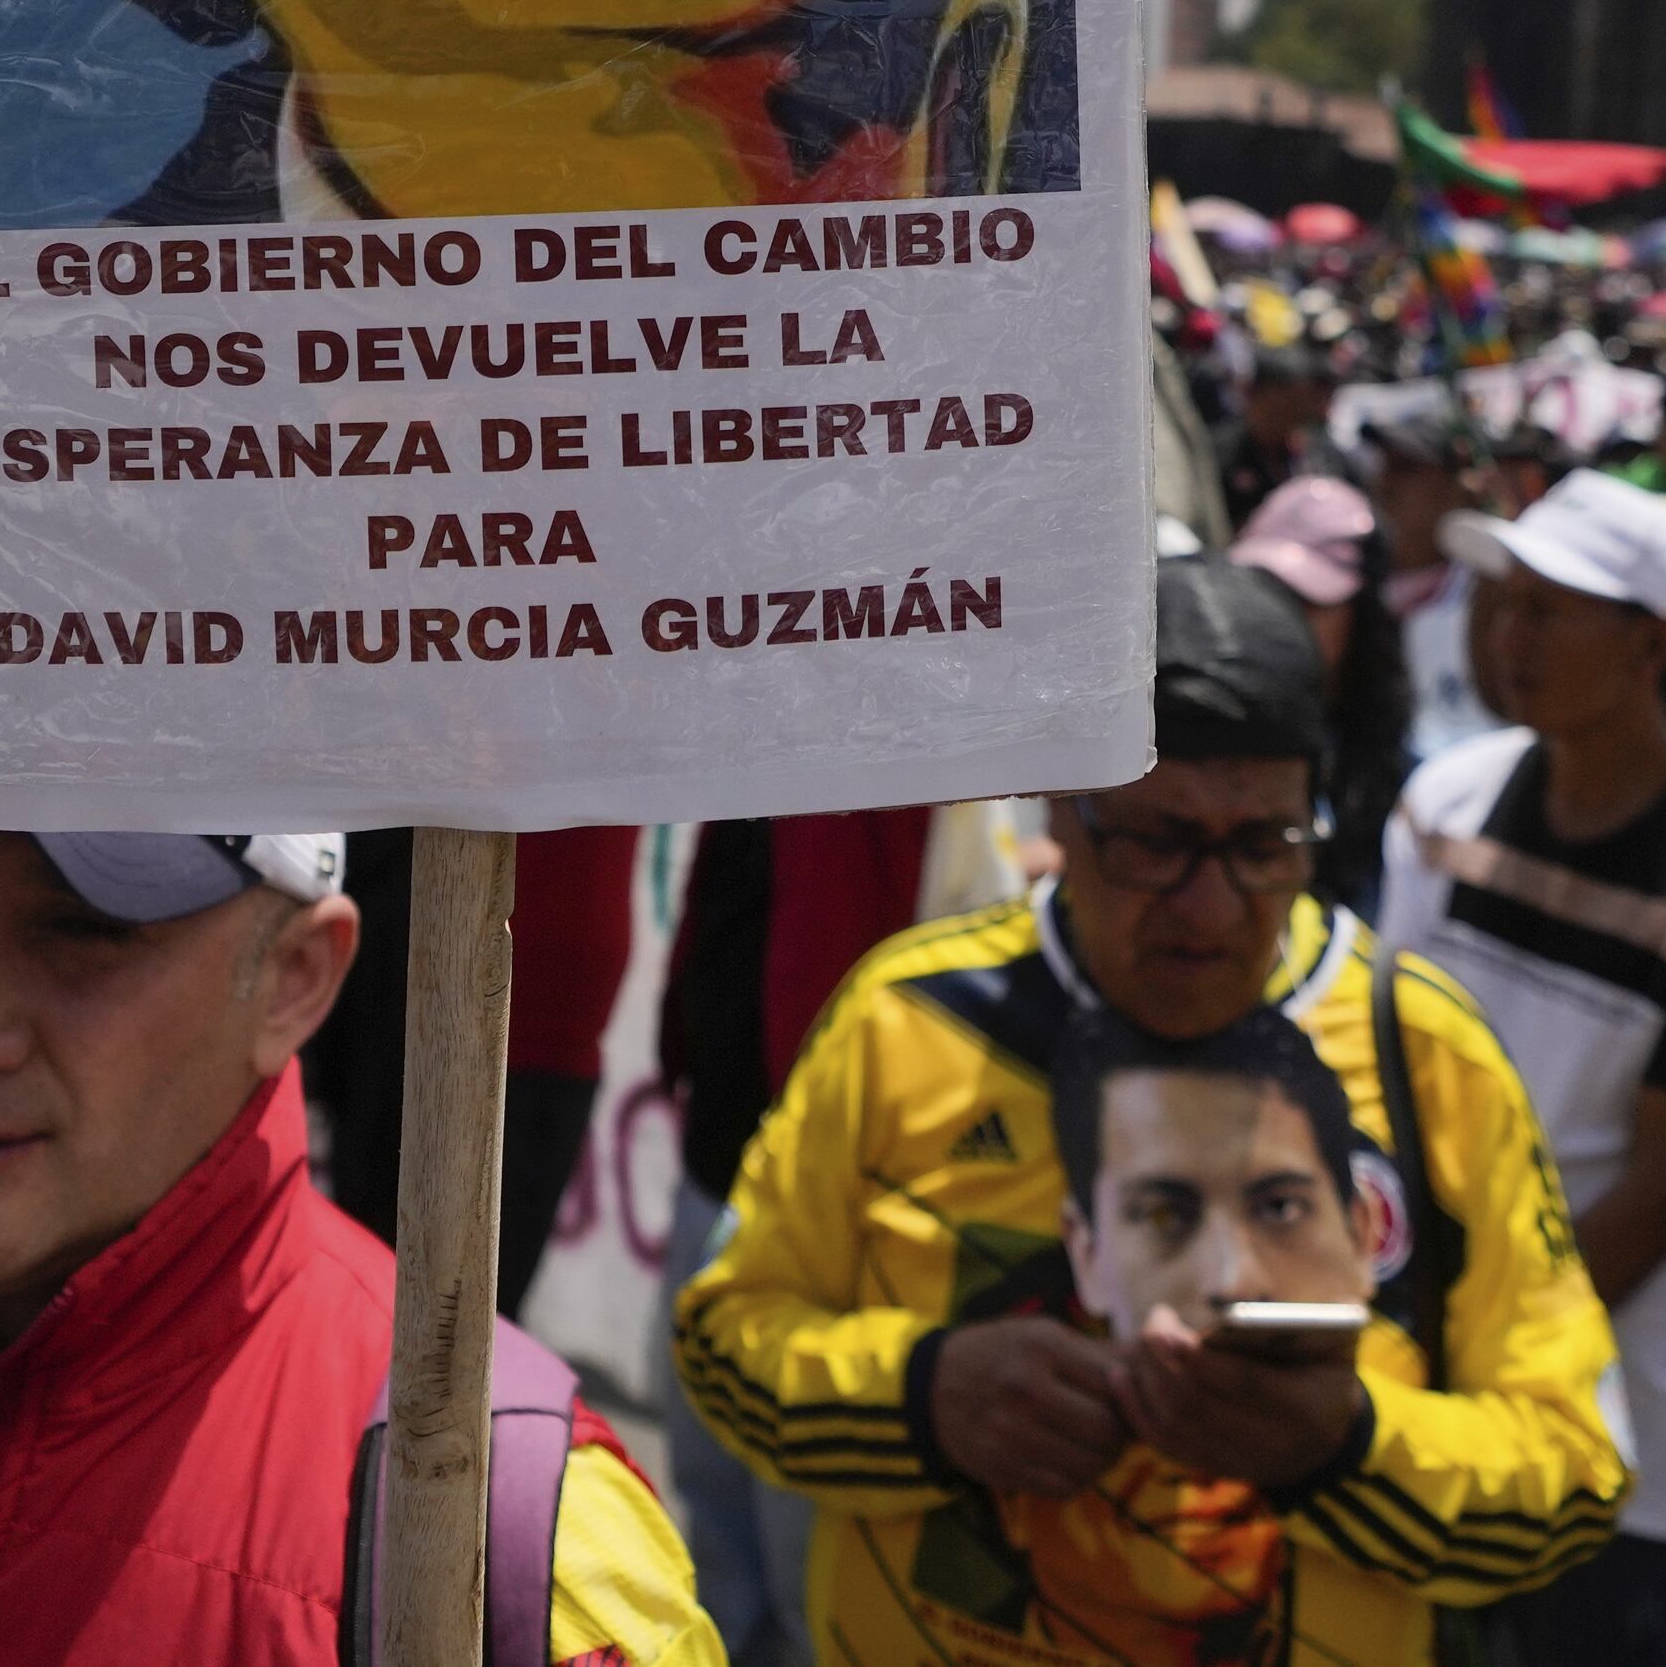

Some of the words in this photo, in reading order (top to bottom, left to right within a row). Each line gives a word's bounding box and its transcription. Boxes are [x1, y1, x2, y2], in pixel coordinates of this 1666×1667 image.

[36, 230, 482, 297] GOBIERNO
[513, 224, 676, 283] DEL
[703, 207, 1035, 276] CAMBIO
[94, 331, 266, 389] NOS
[297, 314, 750, 384] DEVUELVE
[780, 308, 886, 367] LA
[480, 414, 590, 473] DE
[620, 393, 1034, 468] LIBERTAD
[367, 509, 597, 570] PARA
[273, 602, 614, 665] MURCIA
[641, 566, 1003, 653] GUZMÁN
